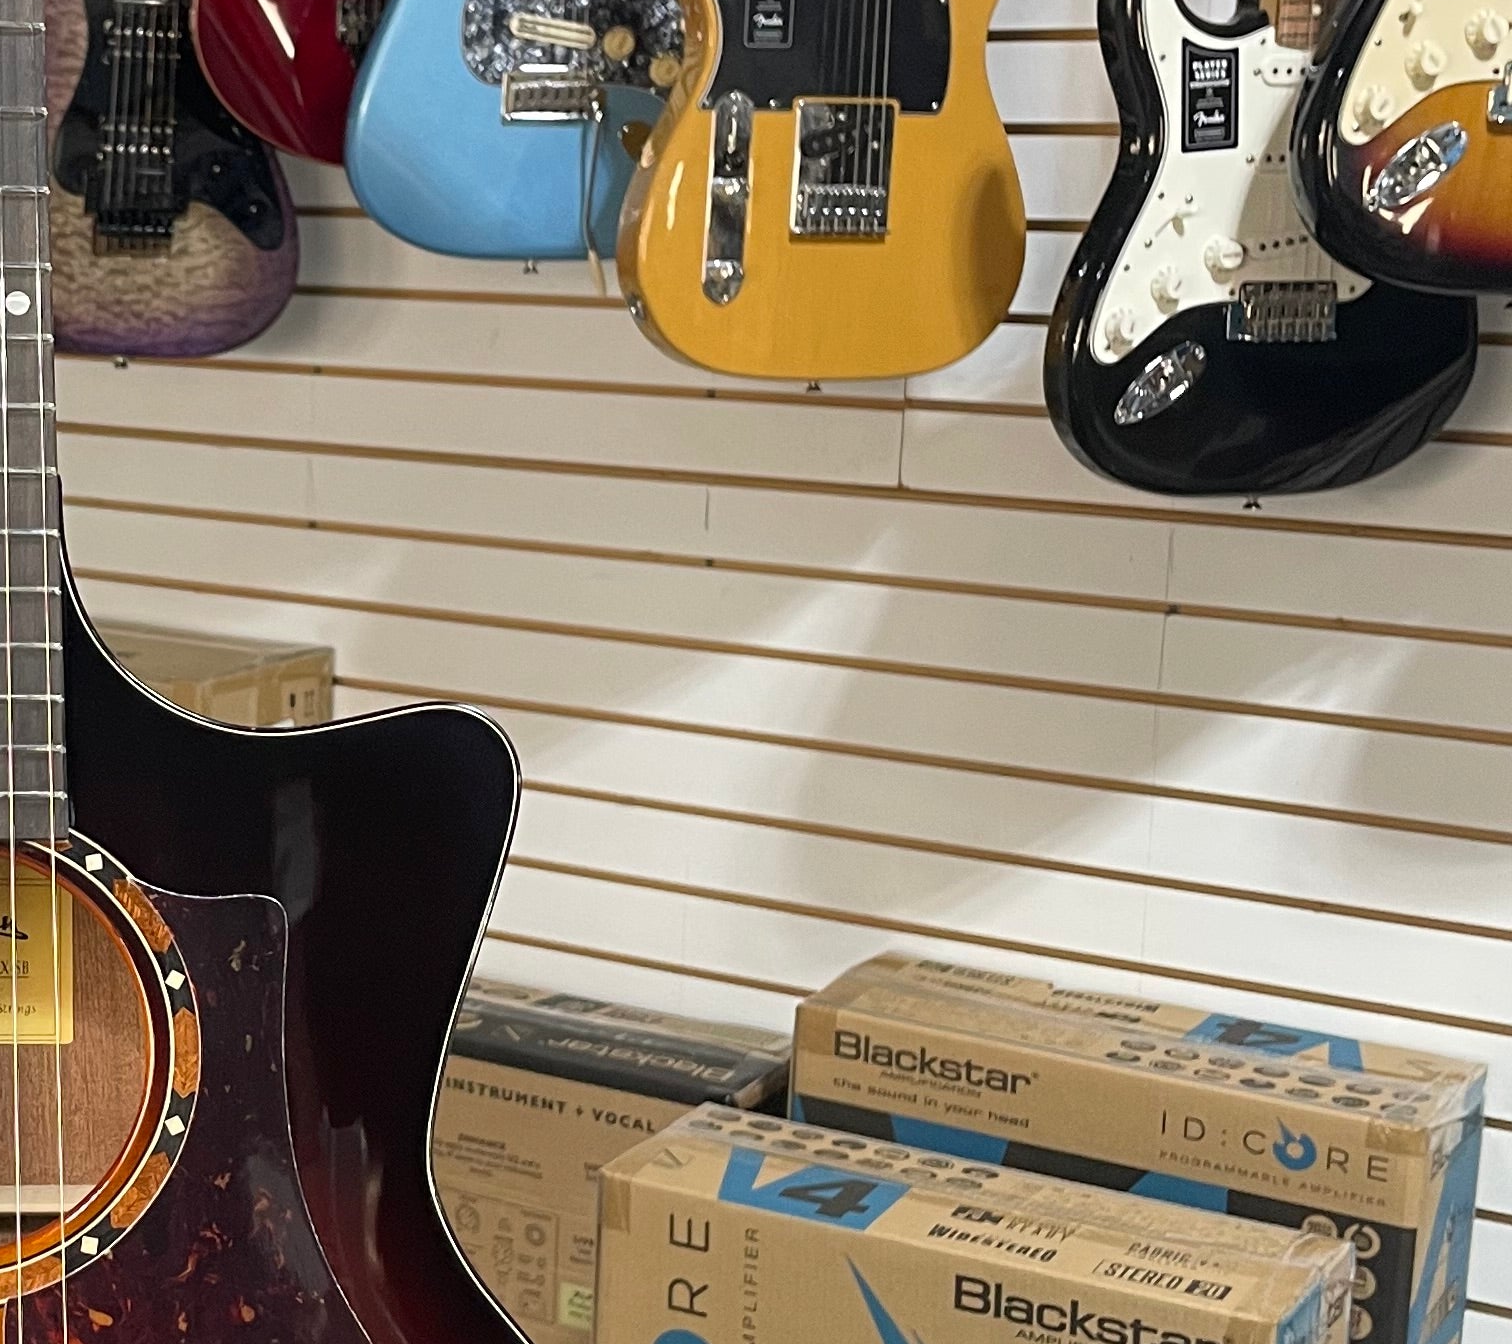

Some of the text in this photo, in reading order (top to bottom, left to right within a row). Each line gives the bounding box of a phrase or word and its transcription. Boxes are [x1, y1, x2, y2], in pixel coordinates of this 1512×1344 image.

[833, 1029, 1034, 1095] Blackstar
[445, 1075, 569, 1116] INSTRUMENT
[591, 1107, 657, 1135] VOCAL
[833, 1076, 1031, 1130] the sound in your head
[1104, 1262, 1185, 1291] STEREO
